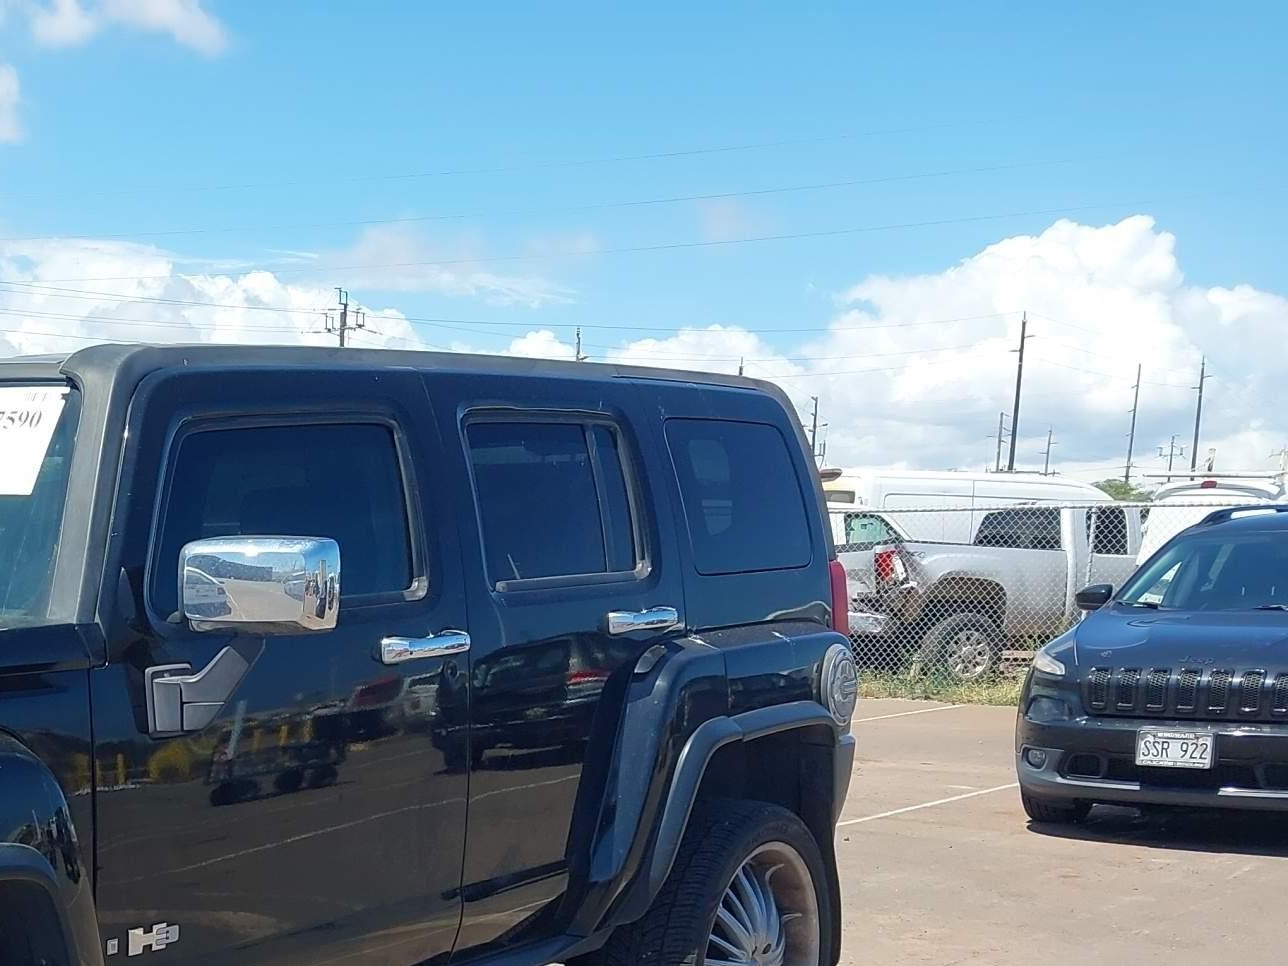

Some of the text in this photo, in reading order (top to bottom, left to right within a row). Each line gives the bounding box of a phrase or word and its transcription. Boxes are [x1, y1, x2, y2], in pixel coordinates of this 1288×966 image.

[1142, 739, 1209, 760] SSR 922
[128, 922, 180, 957] H3
